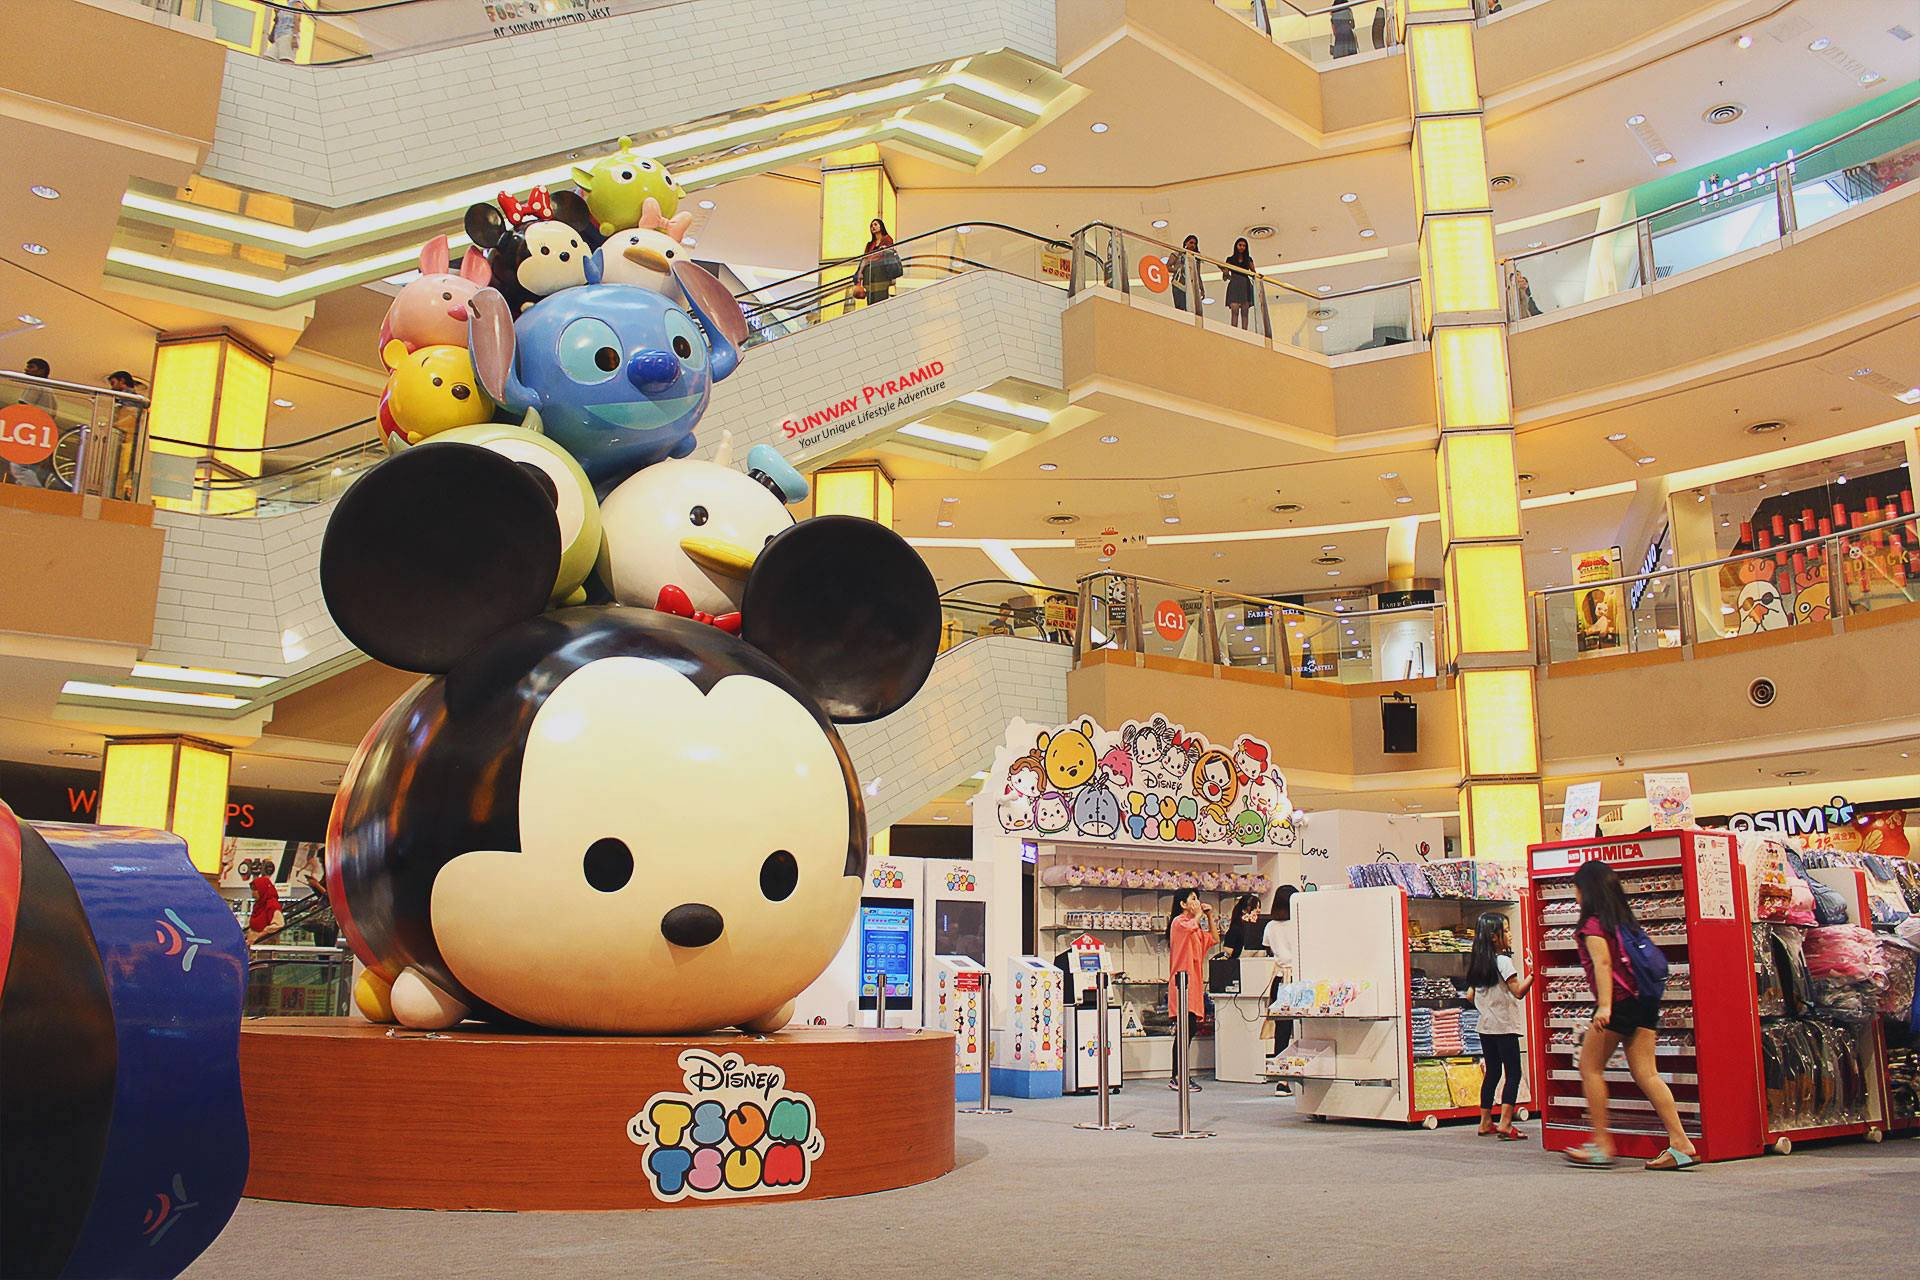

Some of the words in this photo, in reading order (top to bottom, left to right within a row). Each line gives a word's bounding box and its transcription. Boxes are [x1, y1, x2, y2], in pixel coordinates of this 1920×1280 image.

[493, 27, 505, 38] AT
[509, 19, 545, 34] SUNWAY
[546, 12, 586, 26] PYRAMID
[587, 7, 611, 20] WEST
[1147, 264, 1161, 284] G
[782, 395, 858, 438] SUNWAY
[862, 361, 944, 404] PYRAMID
[798, 434, 821, 449] Your
[822, 418, 857, 439] Unique
[857, 401, 896, 424] Lifestyle
[897, 380, 946, 406] Adventure
[0, 420, 51, 448] LG1
[1157, 610, 1184, 630] LG1
[1141, 769, 1183, 796] Disney
[1127, 790, 1199, 821] TSUM
[1128, 814, 1197, 842] TSUM
[1728, 807, 1827, 836] OSIM
[1581, 843, 1644, 862] TOMICA
[684, 1055, 780, 1101] Disney
[649, 1097, 811, 1148] TSUM
[648, 1142, 806, 1195] TSUM
